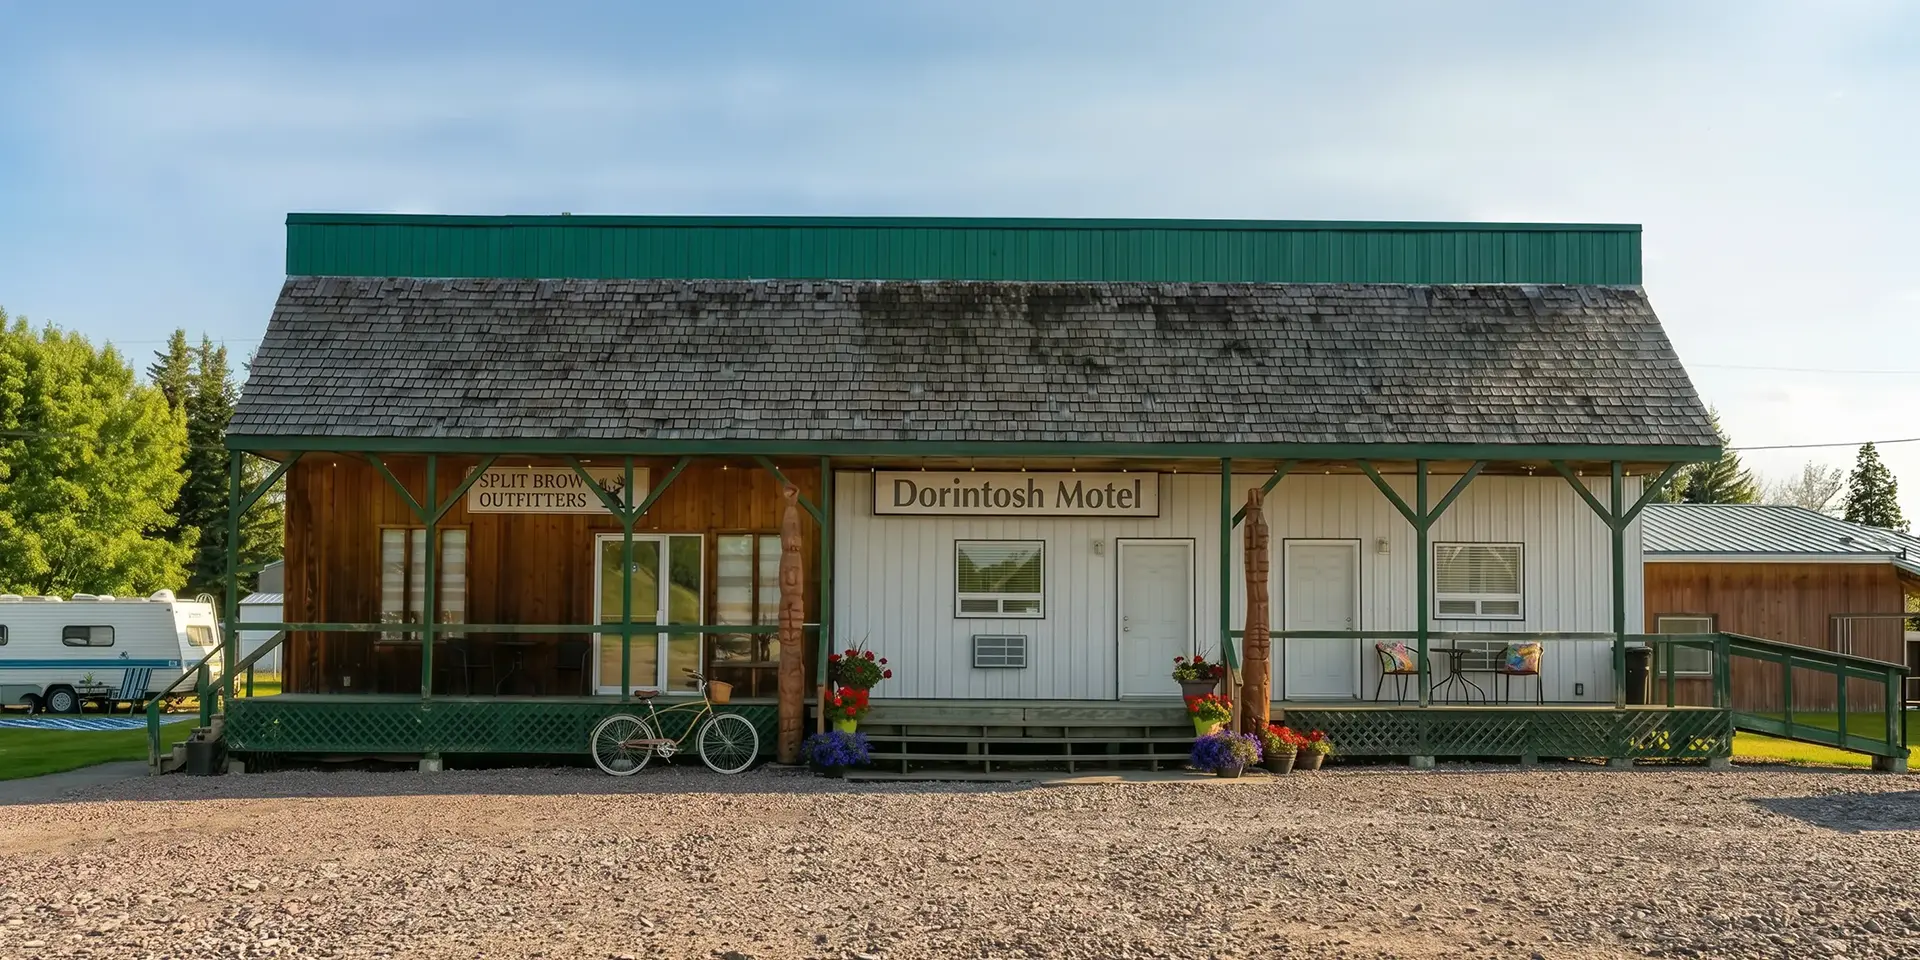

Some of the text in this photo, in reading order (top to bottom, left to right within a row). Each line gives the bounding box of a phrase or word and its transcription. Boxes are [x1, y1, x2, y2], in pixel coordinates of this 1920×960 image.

[479, 474, 584, 488] SPLIT BROW
[479, 492, 587, 508] OUTFITTERS
[893, 478, 1141, 509] Dorintosh Motel
